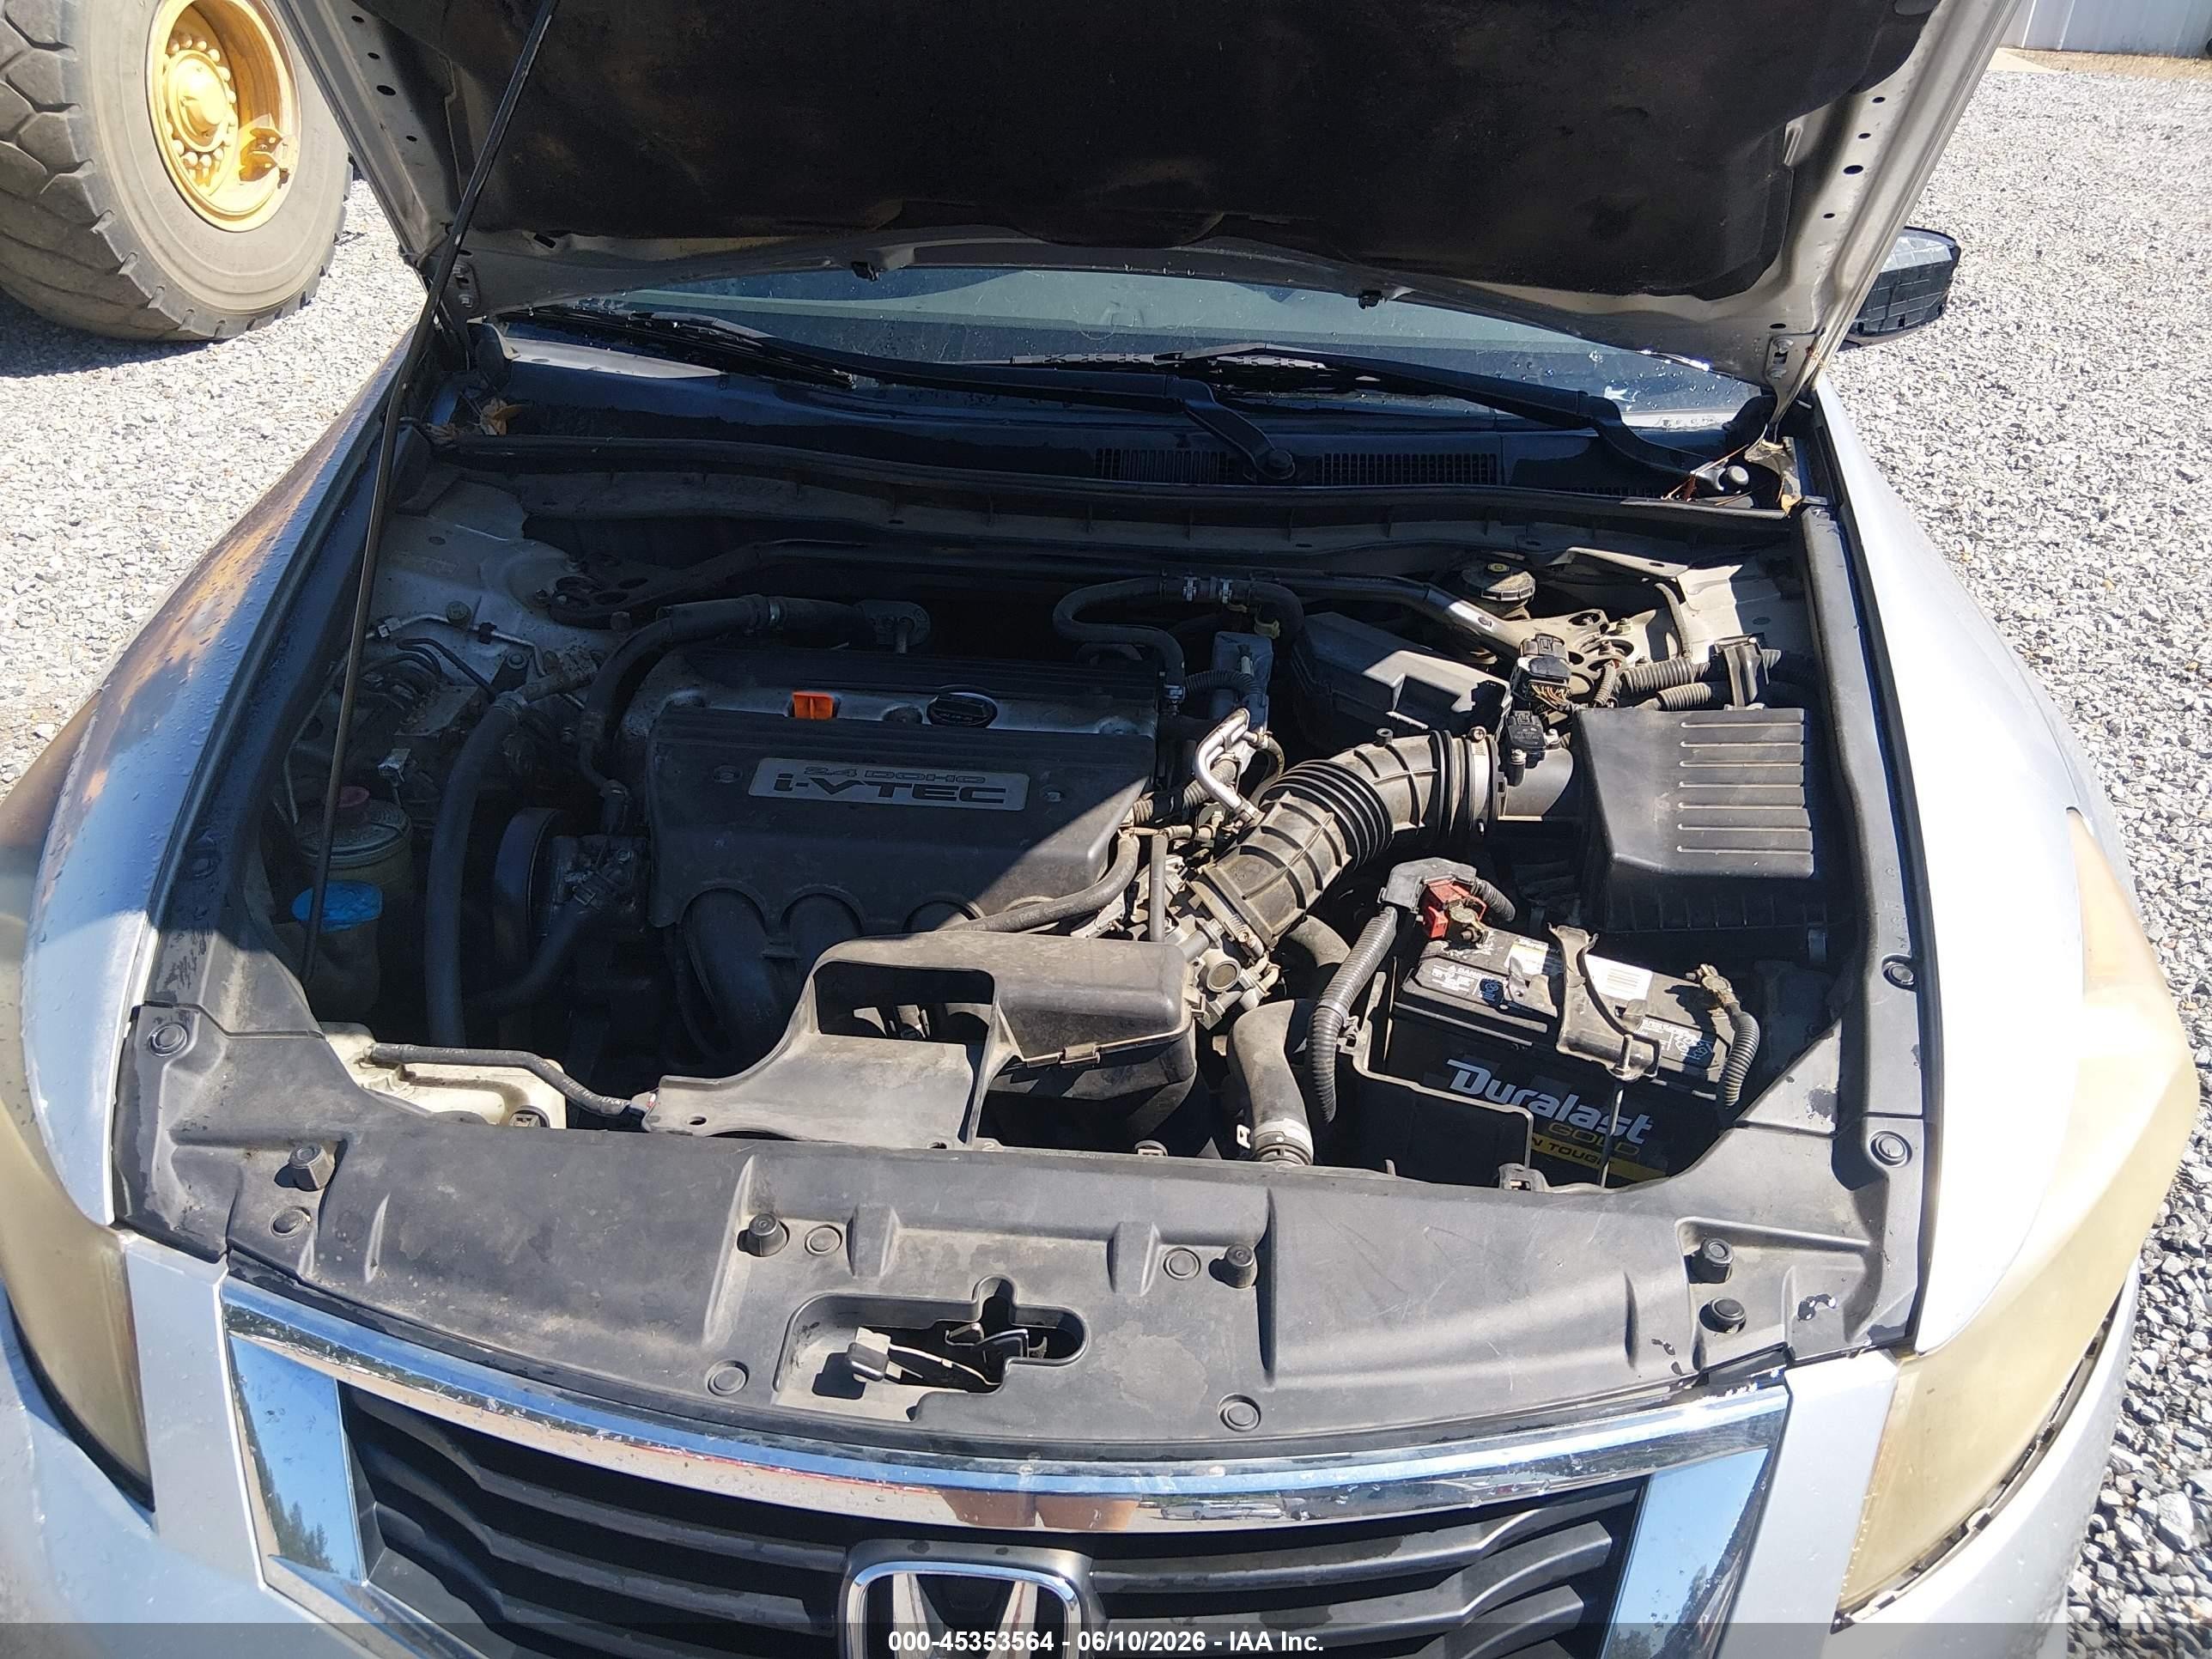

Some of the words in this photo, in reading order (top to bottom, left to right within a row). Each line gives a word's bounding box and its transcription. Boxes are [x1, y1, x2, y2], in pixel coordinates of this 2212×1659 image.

[774, 773, 1006, 804] i-VTEC
[864, 769, 987, 784] DOHC
[1446, 1059, 1654, 1144] Duralast
[1548, 1121, 1640, 1155] GOLD
